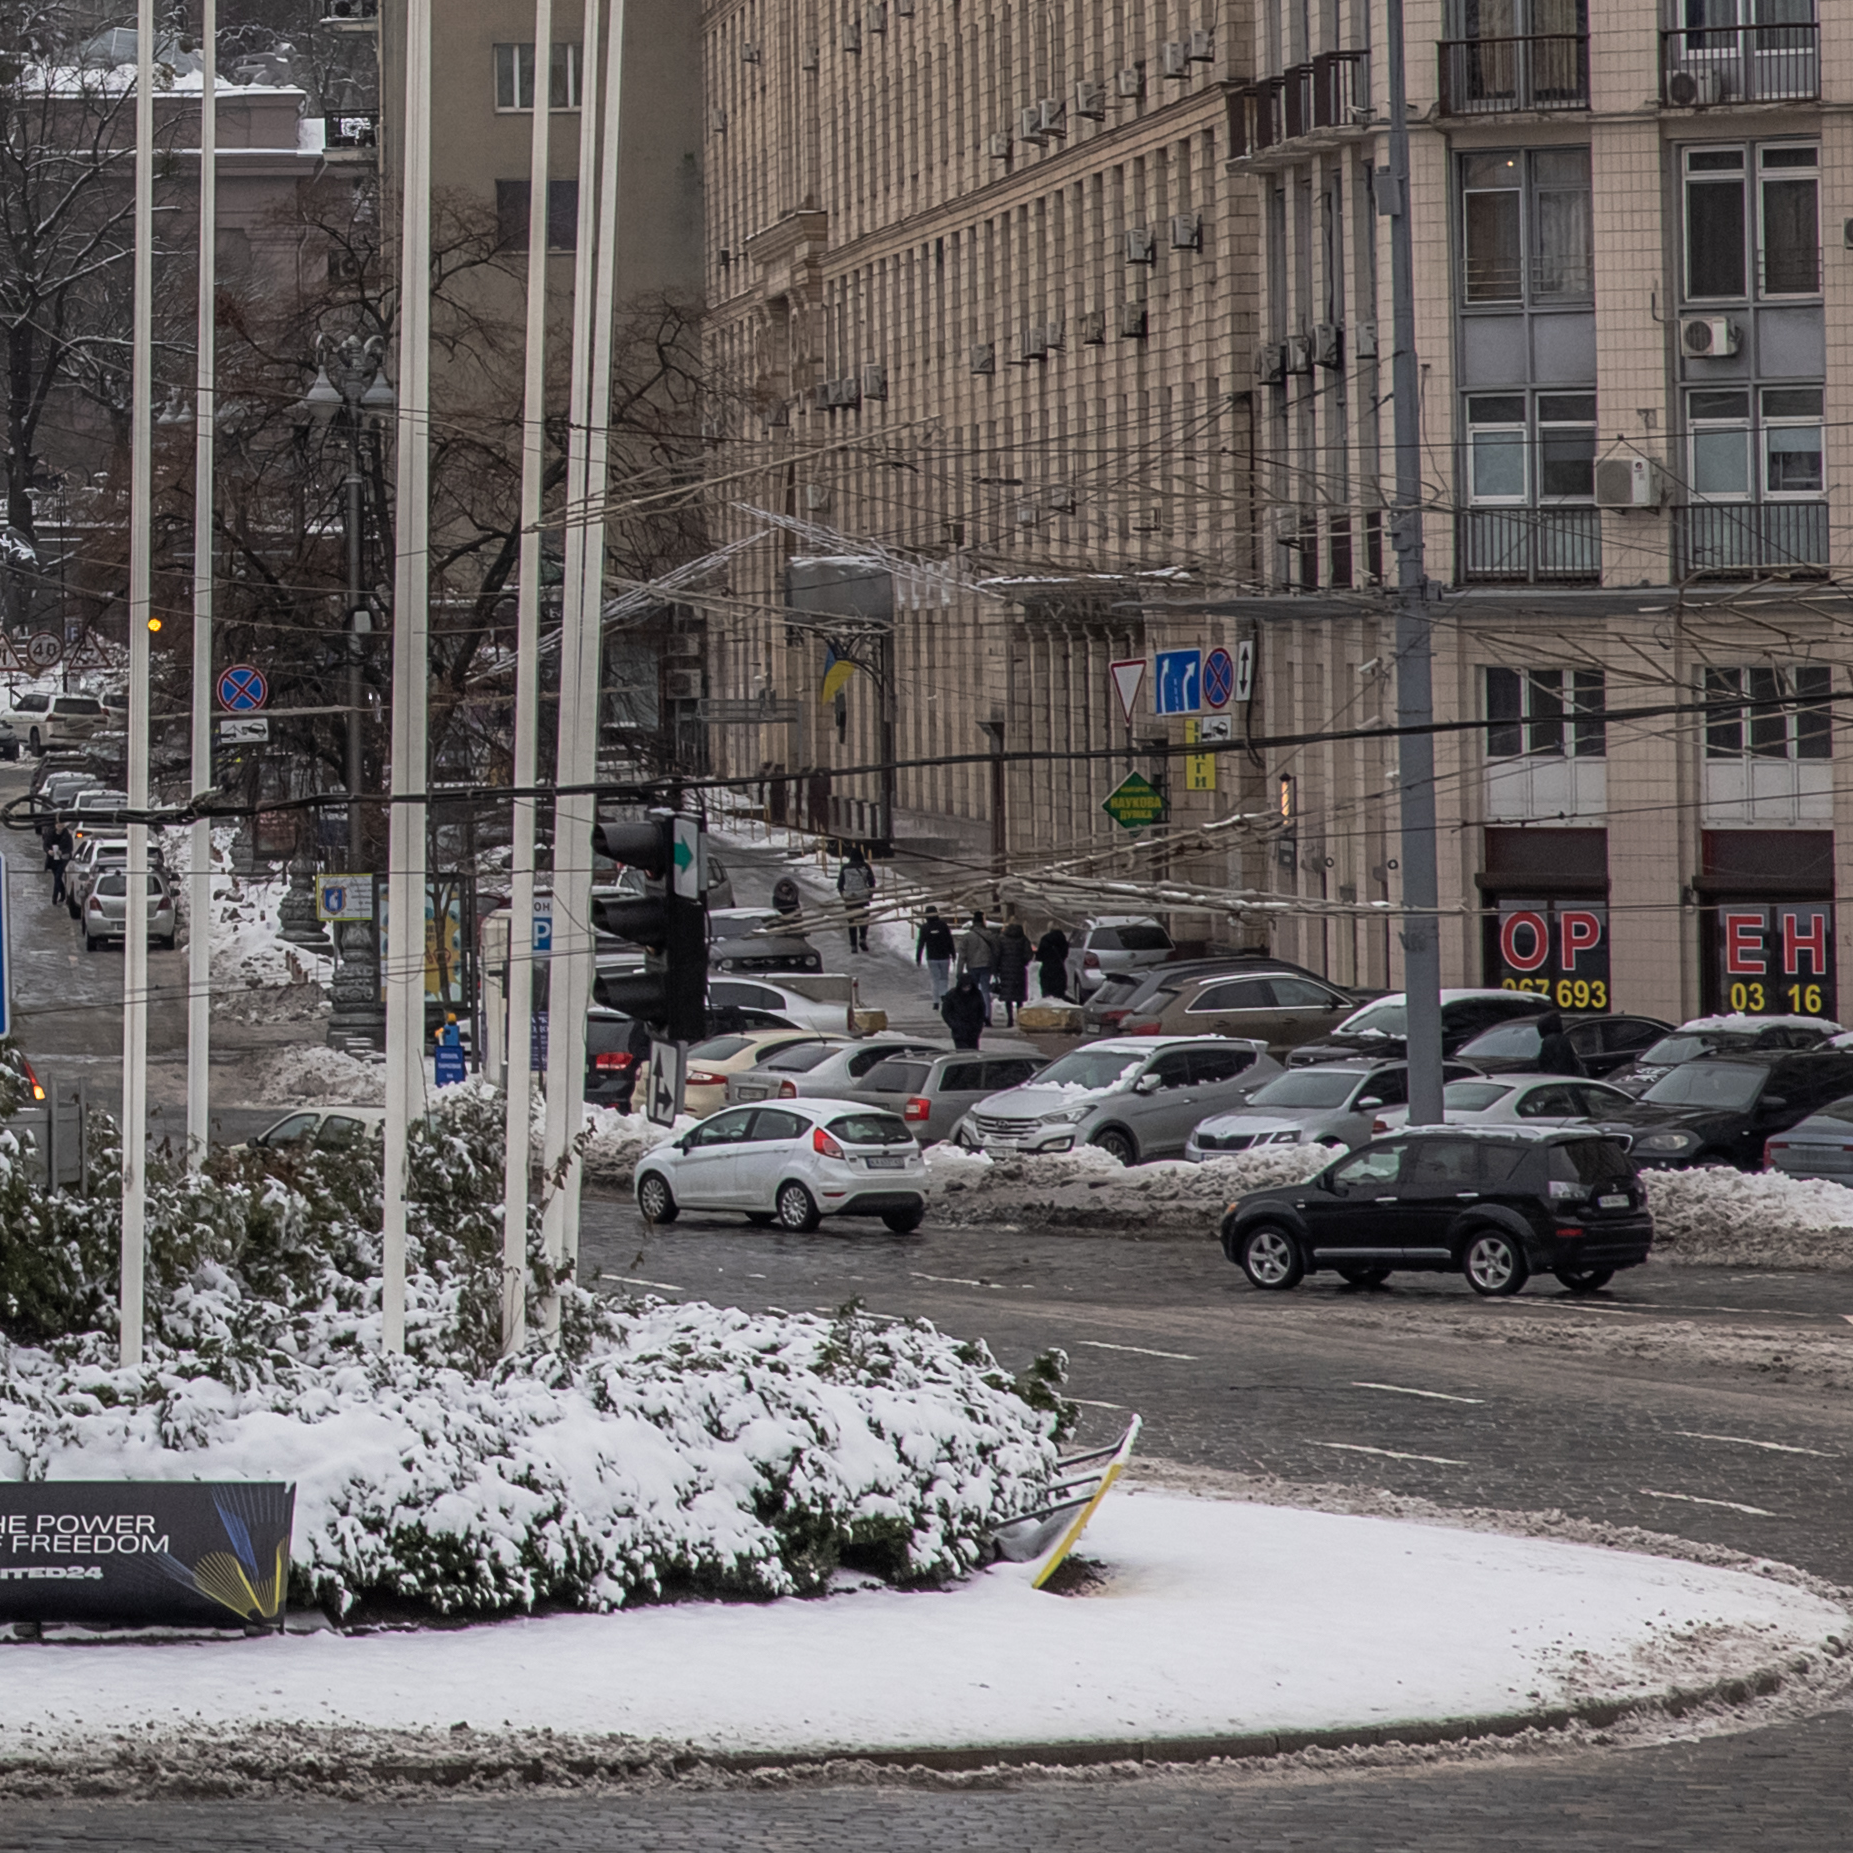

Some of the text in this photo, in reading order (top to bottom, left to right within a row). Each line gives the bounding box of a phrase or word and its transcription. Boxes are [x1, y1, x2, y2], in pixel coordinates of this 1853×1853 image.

[33, 642, 57, 656] 40
[1556, 979, 1607, 1008] 693
[1730, 982, 1822, 1013] 03 16
[36, 1515, 156, 1534] POWER
[12, 1534, 169, 1554] FREEDOM
